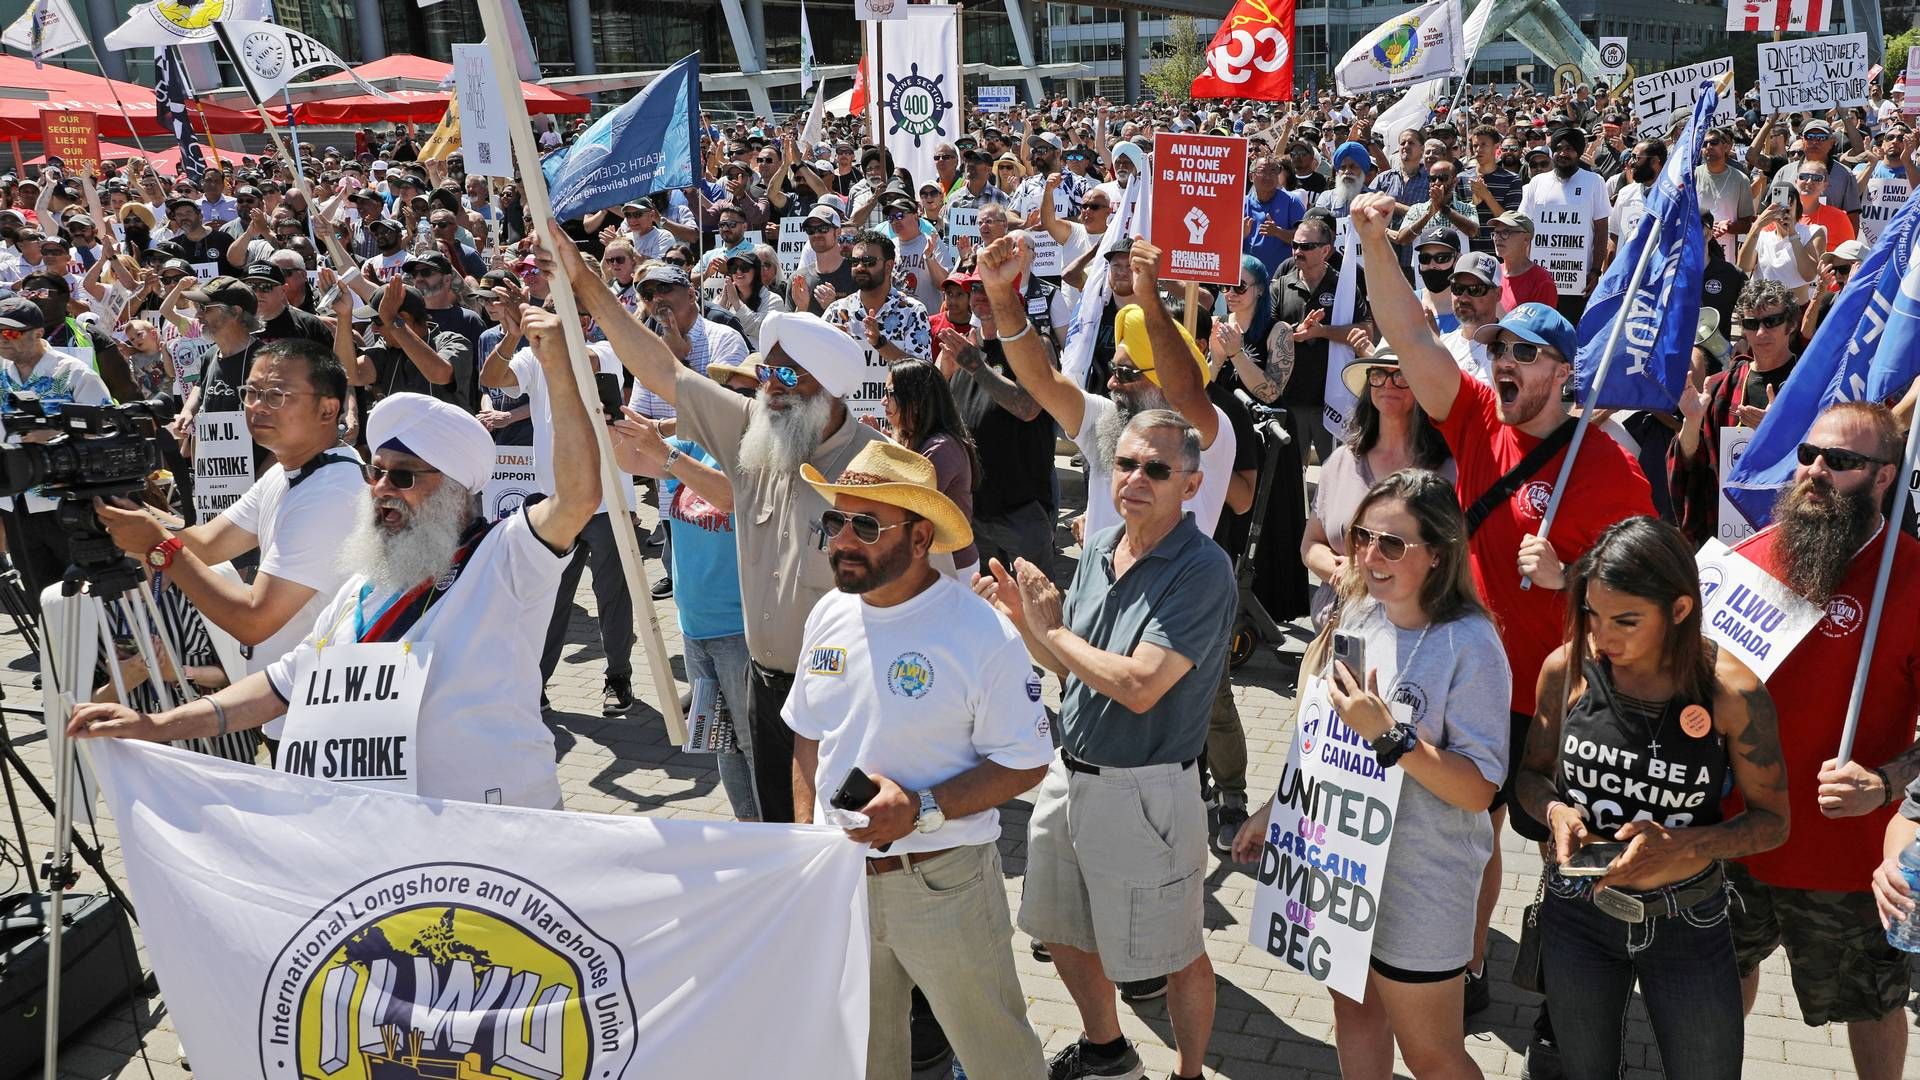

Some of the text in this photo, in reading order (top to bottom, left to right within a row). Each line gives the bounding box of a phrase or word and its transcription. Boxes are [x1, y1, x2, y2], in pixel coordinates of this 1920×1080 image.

[1637, 68, 1697, 96] STAND
[892, 78, 912, 110] MARINE
[916, 78, 942, 111] SECTION
[904, 94, 928, 116] 400
[48, 126, 92, 134] SECURITY
[58, 115, 80, 124] OUR
[902, 117, 935, 134] ILWU
[1708, 112, 1735, 128] ACK
[55, 136, 87, 144] LIES IN
[1171, 144, 1230, 158] AN INJURY
[1180, 158, 1220, 170] TO ONE
[1162, 170, 1236, 185] IS AN INJURY
[1180, 184, 1216, 197] TO ALL
[1883, 185, 1907, 195] ILWU
[1540, 211, 1581, 225] I.L.W.U.
[780, 242, 792, 252] ON
[1534, 234, 1584, 248] ON STRIKE
[1172, 258, 1220, 271] ALTERNATIVE
[1550, 260, 1584, 272] MARITIME
[200, 422, 240, 442] I.L.W.U.
[197, 456, 249, 477] ON STRIKE
[1725, 584, 1787, 634] ILWU
[1711, 610, 1772, 662] CANADA
[305, 664, 399, 706] I.L.W.U.
[285, 736, 407, 779] ON STRIKE
[1321, 742, 1386, 782] CANADA
[1564, 734, 1711, 786] DONT BE A
[1563, 760, 1706, 808] FUCKING
[1277, 763, 1392, 846] UNITED
[1270, 822, 1368, 886] BARGAIN
[1258, 841, 1376, 932] DIVIDED
[1266, 912, 1332, 982] BEG
[270, 872, 620, 1054] International Longshore and Warehouse Union
[318, 957, 573, 1080] ILWU
